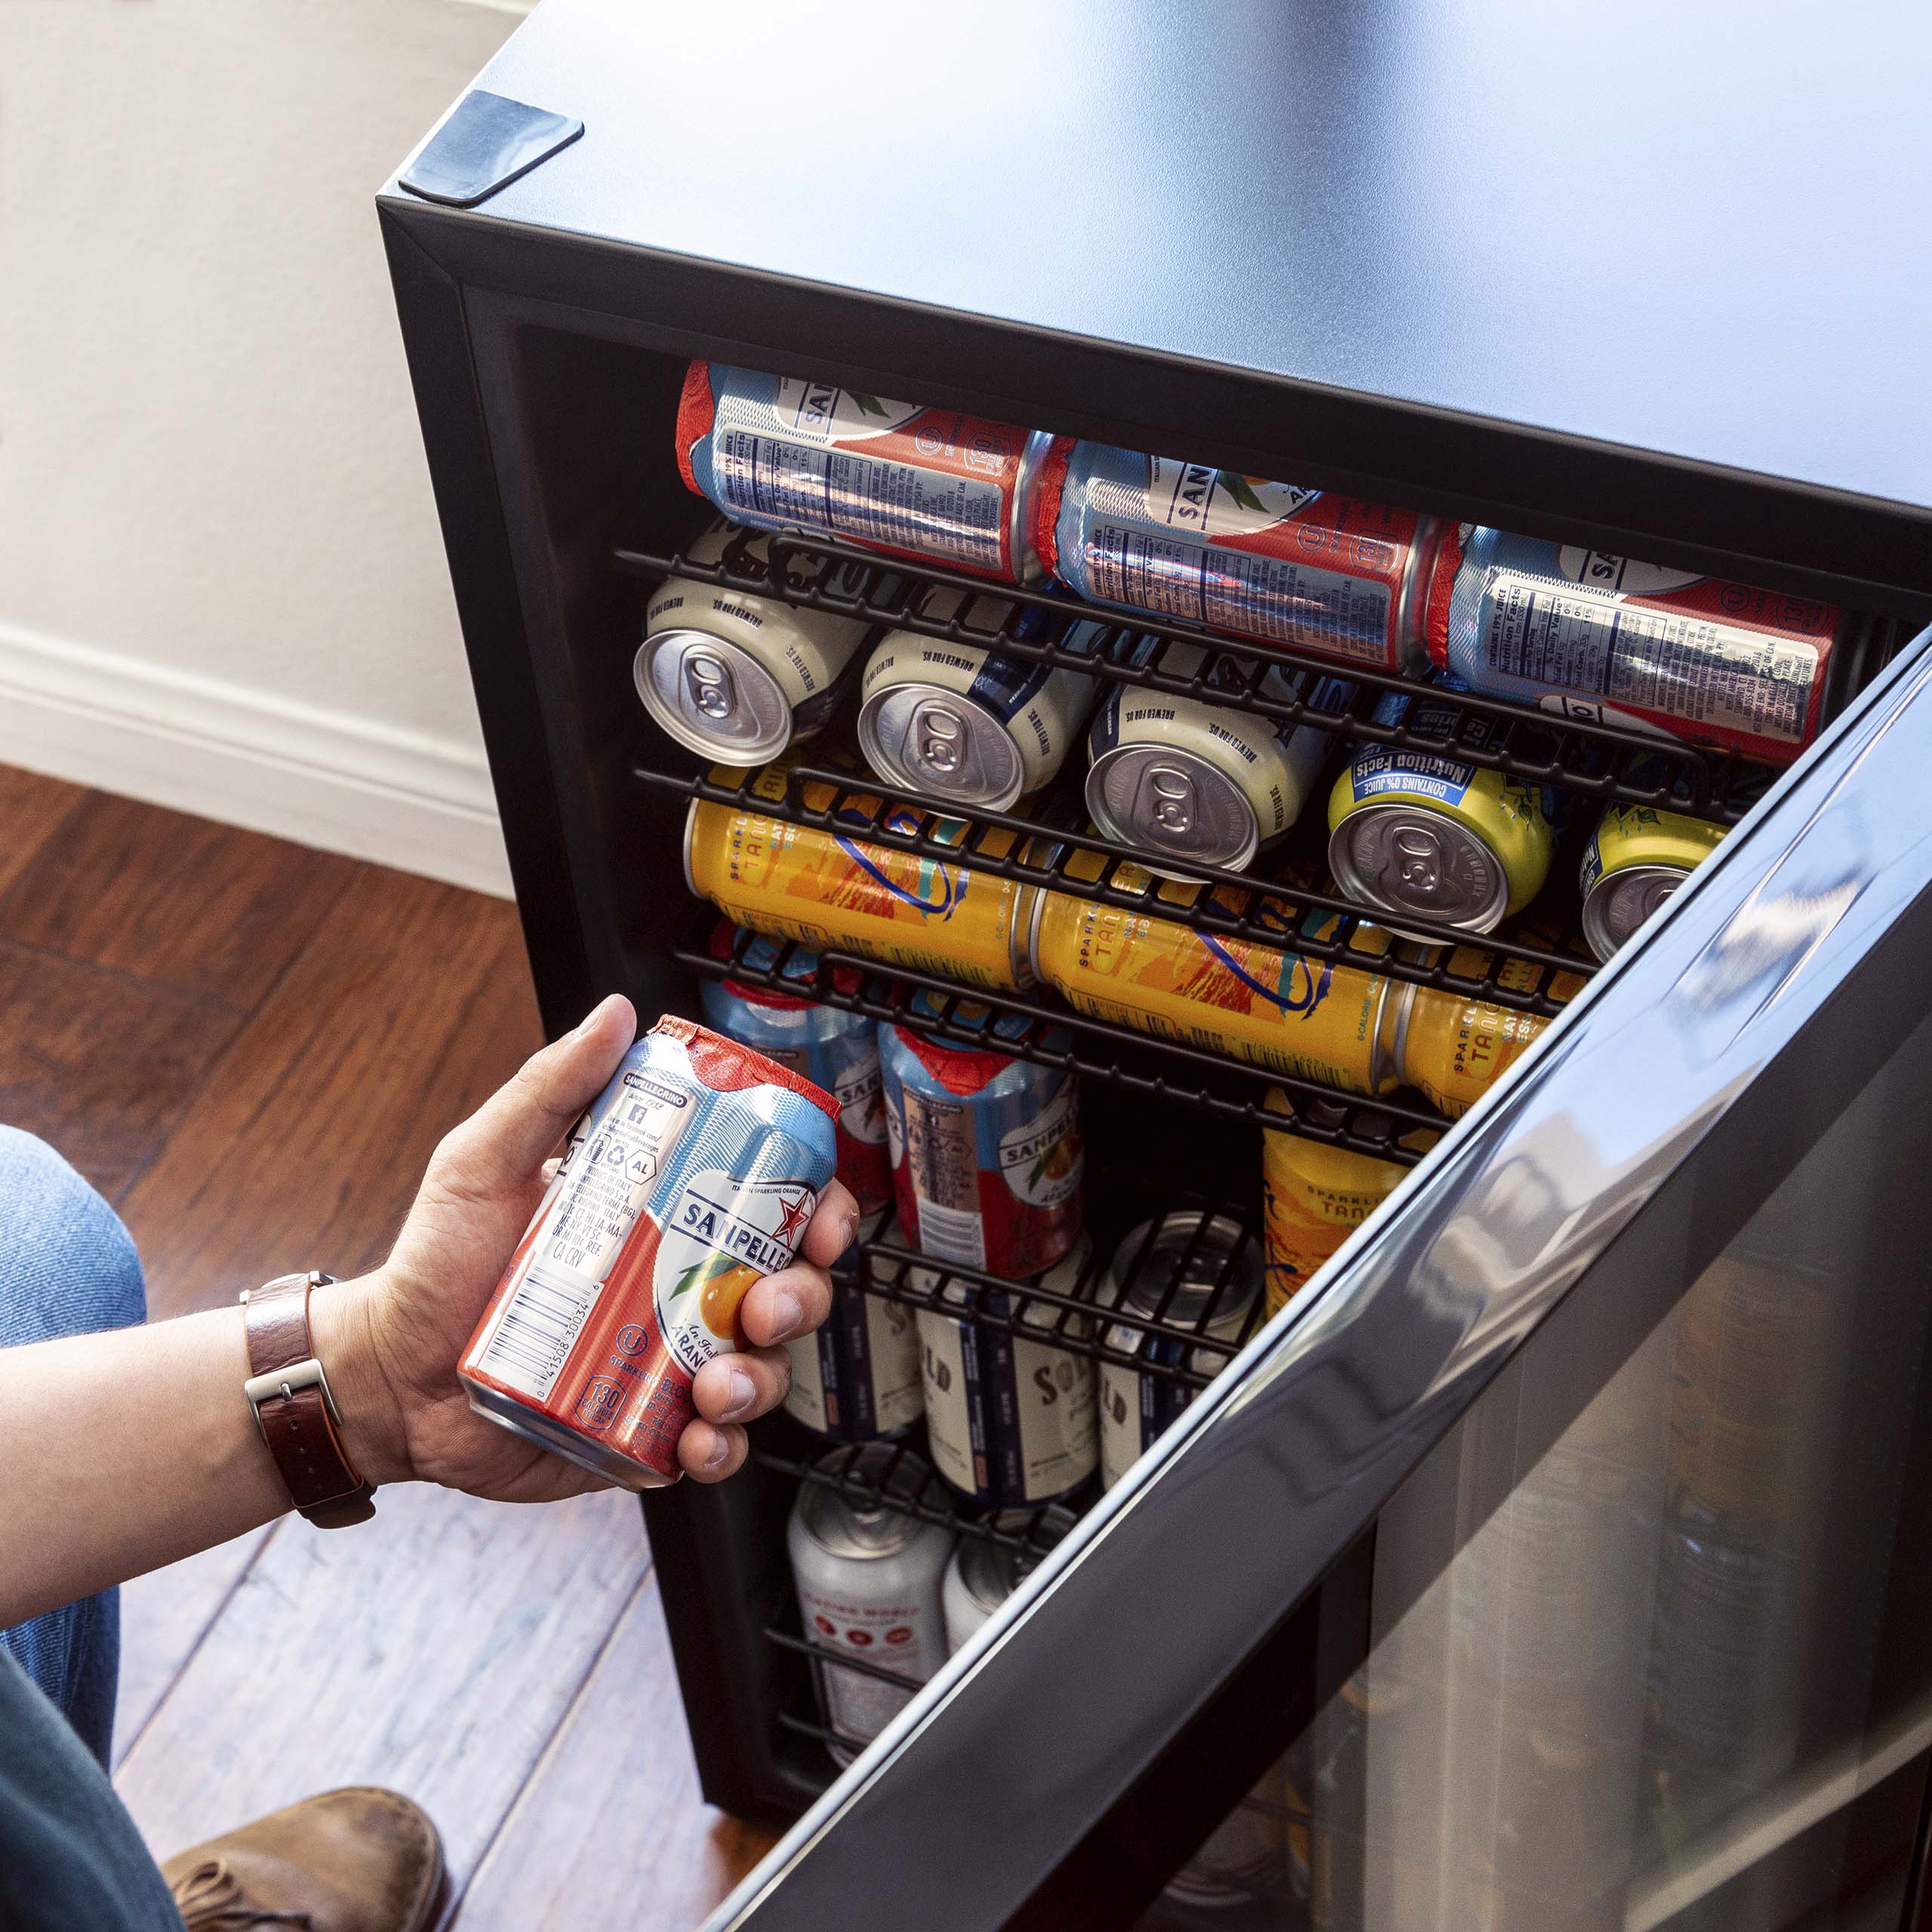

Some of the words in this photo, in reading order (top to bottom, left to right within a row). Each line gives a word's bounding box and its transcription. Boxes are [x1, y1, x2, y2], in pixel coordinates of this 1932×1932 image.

[735, 433, 745, 465] Facts
[774, 474, 782, 493] Daily
[1177, 465, 1212, 519] SAN
[1094, 528, 1102, 549] JUICE
[1104, 528, 1115, 559] Facts
[1155, 541, 1162, 553] 0%
[1355, 534, 1378, 561] 130
[1167, 543, 1173, 555] 0%
[1495, 587, 1507, 611] JUICE
[1506, 587, 1521, 622] Facts
[1563, 601, 1571, 614] 0%
[734, 605, 763, 629] BREWED
[1492, 613, 1502, 629] 19%
[1515, 606, 1525, 621] (330
[1583, 605, 1592, 624] 11%
[1527, 628, 1537, 648] Serving
[1565, 638, 1577, 657] 10mg
[1574, 604, 1582, 617] 0%
[1488, 632, 1500, 666] CONTAINS
[1501, 626, 1515, 672] Nutrition
[1546, 632, 1558, 654] Daily
[1557, 641, 1566, 651] 0g
[1579, 633, 1589, 648] 33g
[1716, 641, 1726, 651] BY:
[1764, 641, 1776, 654] CAN.
[921, 651, 933, 662] US.
[932, 651, 945, 664] FOR
[1555, 651, 1564, 665] Fat
[1576, 649, 1585, 669] Carb.
[1587, 644, 1598, 658] 29g
[1714, 651, 1723, 663] USA
[1763, 654, 1772, 663] OF
[875, 655, 894, 675] BREWED
[945, 654, 975, 672] BREWED
[1586, 660, 1595, 683] Sugars
[1712, 663, 1721, 675] THE
[1719, 661, 1731, 682] WATERS
[1738, 654, 1752, 675] 06902
[1789, 655, 1803, 684] SUNLIGHT
[798, 665, 816, 693] BREWED
[1554, 666, 1562, 684] Total
[1574, 671, 1583, 688] Total
[1595, 668, 1604, 694] Protein
[1727, 669, 1739, 694] AMERICA
[1758, 679, 1767, 689] SEE
[1768, 678, 1780, 695] CLEAN
[1777, 678, 1790, 706] ODORLESS
[1785, 686, 1798, 703] DIRECT
[1706, 683, 1718, 713] DISTRIBUTED
[1724, 694, 1734, 709] NORTH
[1124, 712, 1134, 722] US.
[1135, 709, 1146, 721] FOR
[1146, 708, 1176, 721] BREWED
[1754, 704, 1765, 722] BEFORE
[1764, 709, 1774, 723] STORE
[1775, 706, 1784, 718] AND
[1784, 704, 1795, 719] FROM
[1208, 722, 1220, 735] US.
[1232, 739, 1258, 764] BREWED
[1356, 755, 1393, 777] Facts
[1396, 754, 1466, 783] Nutrition
[1364, 777, 1388, 795] JUICE
[1386, 777, 1401, 789] 0%
[1401, 778, 1447, 797] CONTAINS
[1095, 905, 1121, 956] TAN
[623, 1073, 685, 1107] SANPELLEGRINO
[585, 1164, 607, 1180] PRODUCT
[614, 1177, 633, 1192] ITALY
[632, 1161, 648, 1176] AL
[572, 1182, 604, 1203] PELLEGRINO
[601, 1196, 620, 1211] TERME
[618, 1204, 638, 1220] (BG),
[613, 1190, 631, 1204] S.p.A.
[576, 1196, 601, 1213] RUSPINO
[602, 1208, 621, 1222] ITALY
[551, 1239, 567, 1261] CA
[563, 1245, 586, 1269] CRV
[584, 1239, 603, 1257] REF.
[546, 1340, 570, 1380] 41508
[566, 1303, 589, 1340] 30034
[606, 1353, 663, 1387] SPARKLING
[588, 1379, 622, 1411] 130
[580, 1396, 616, 1420] CALORIES
